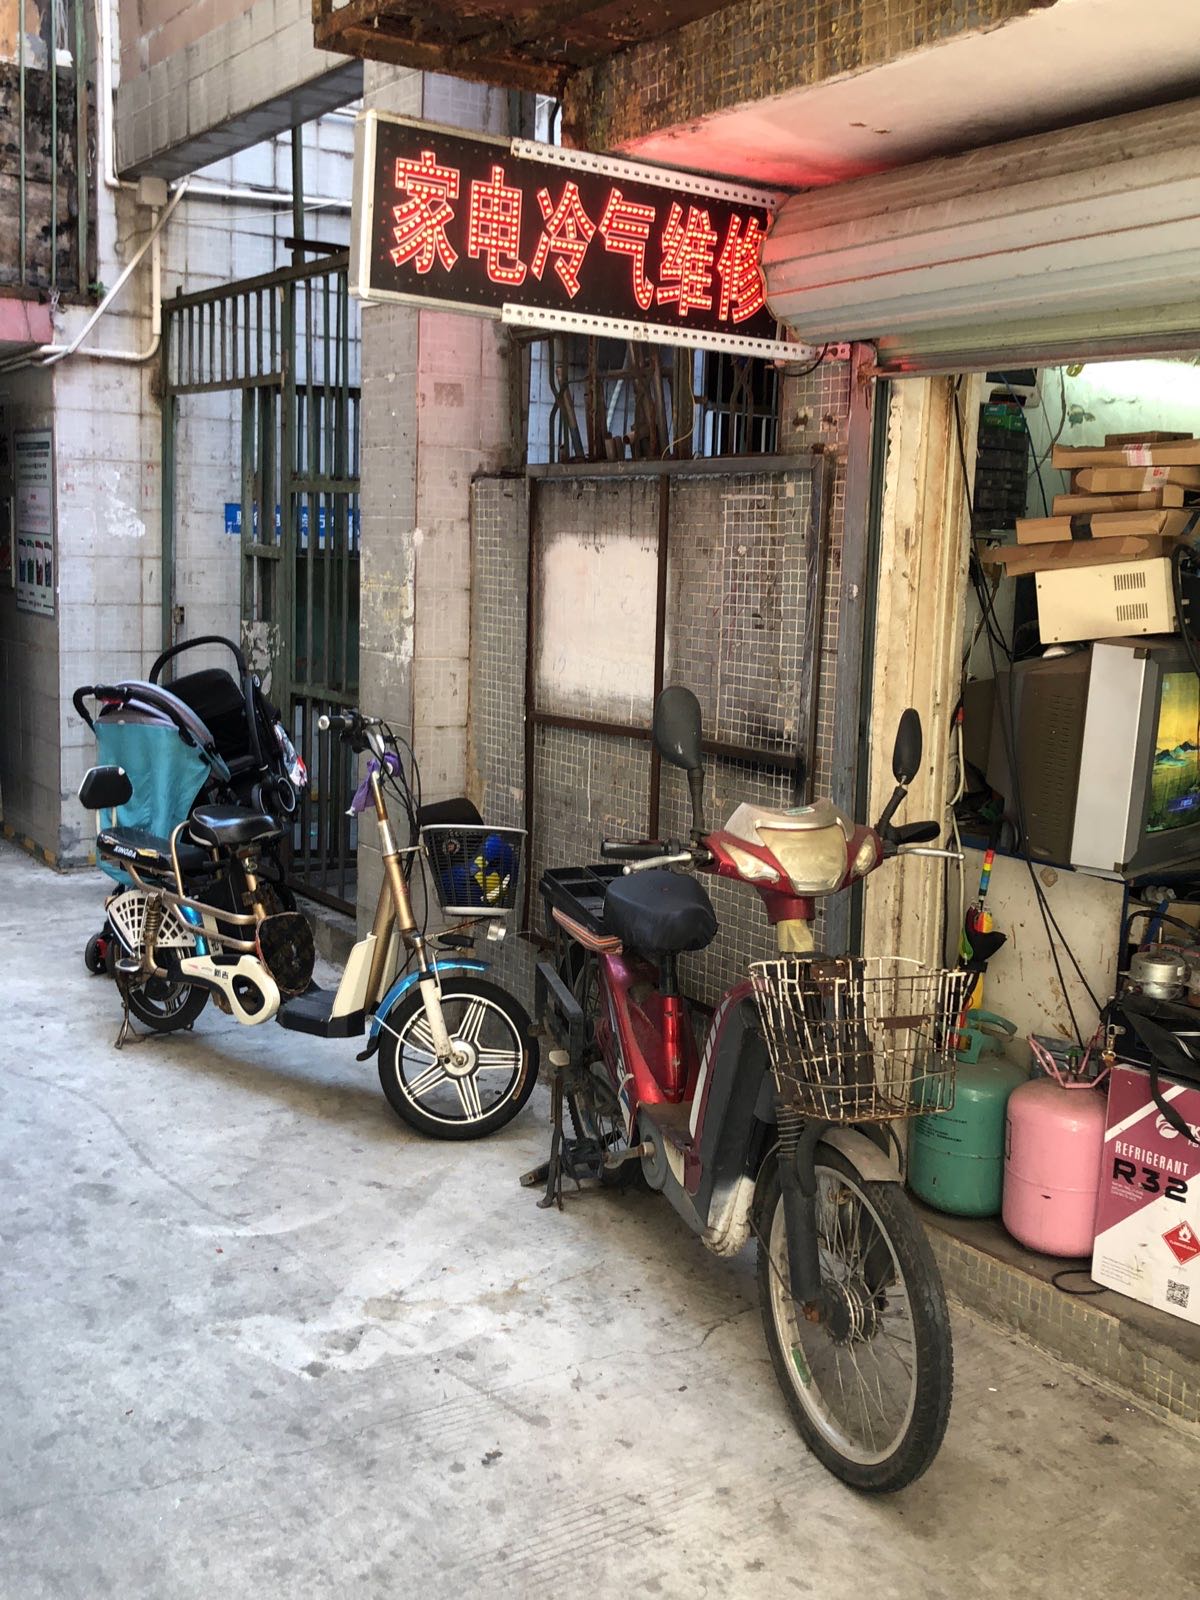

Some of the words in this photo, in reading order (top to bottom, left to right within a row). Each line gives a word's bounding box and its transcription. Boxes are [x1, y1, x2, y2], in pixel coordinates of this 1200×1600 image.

[390, 151, 767, 324] 家电冷气维修
[113, 845, 137, 859] XINGDA
[1115, 1140, 1189, 1176] REFRIGERANT
[1112, 1157, 1189, 1204] R32
